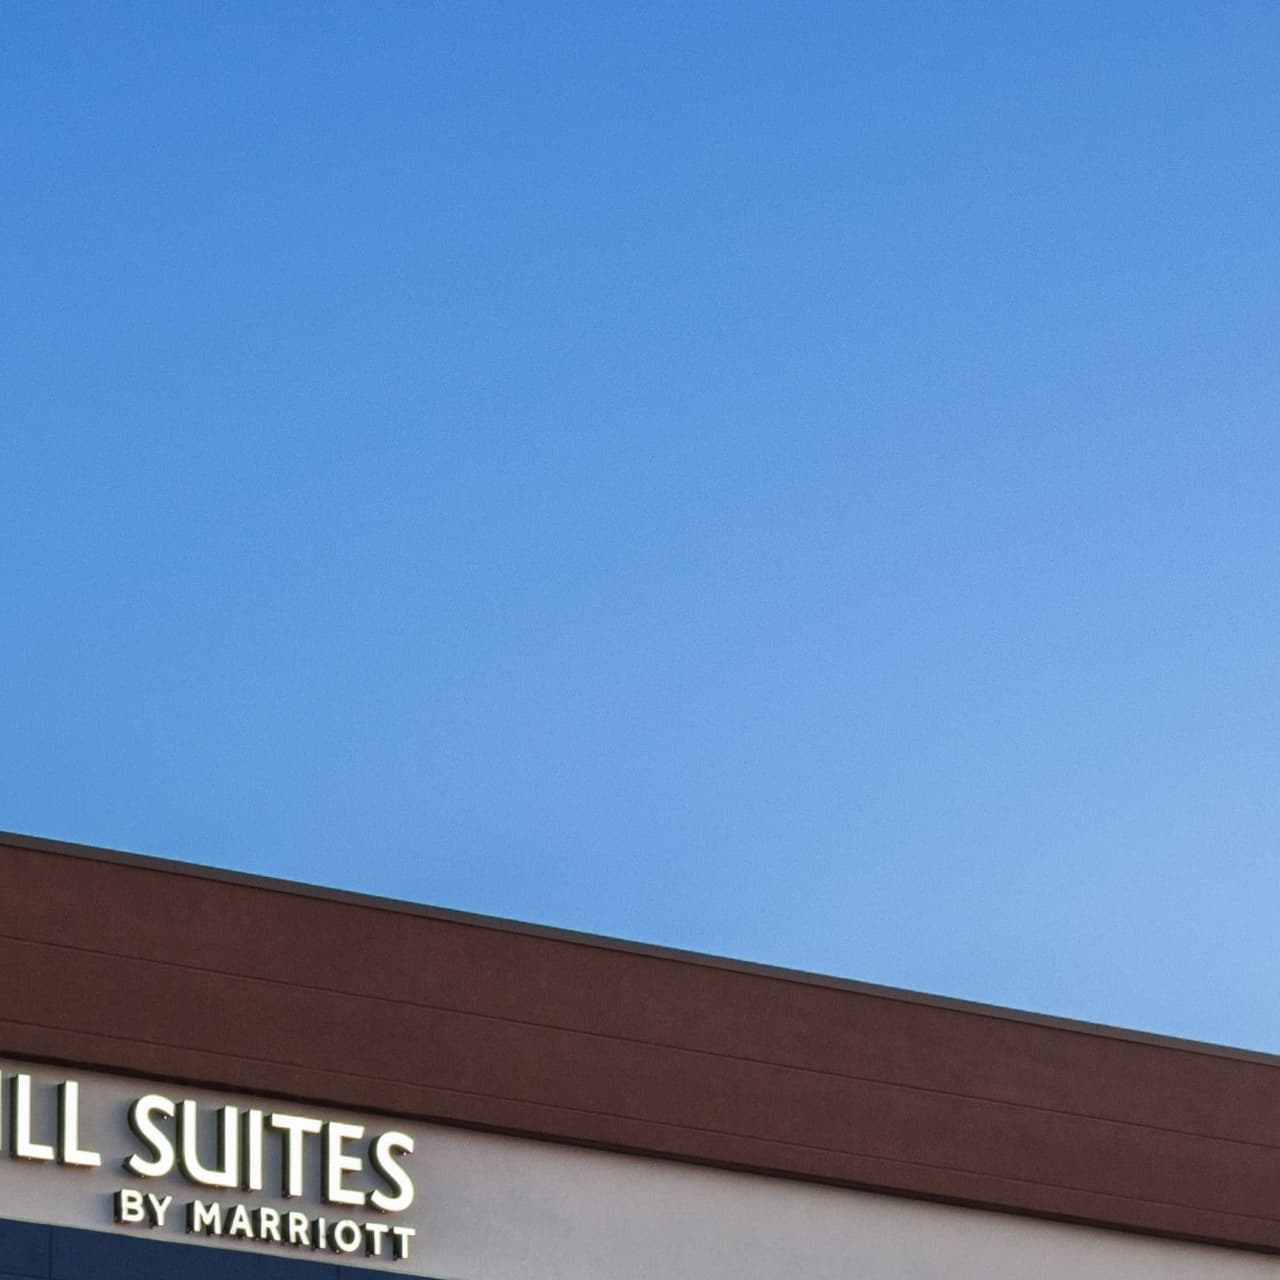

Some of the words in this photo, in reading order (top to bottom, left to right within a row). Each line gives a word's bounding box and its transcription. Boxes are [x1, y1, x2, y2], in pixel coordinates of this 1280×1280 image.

[126, 1094, 416, 1212] SUITES
[119, 1188, 173, 1227] BY
[191, 1201, 416, 1260] MARRIOTT
